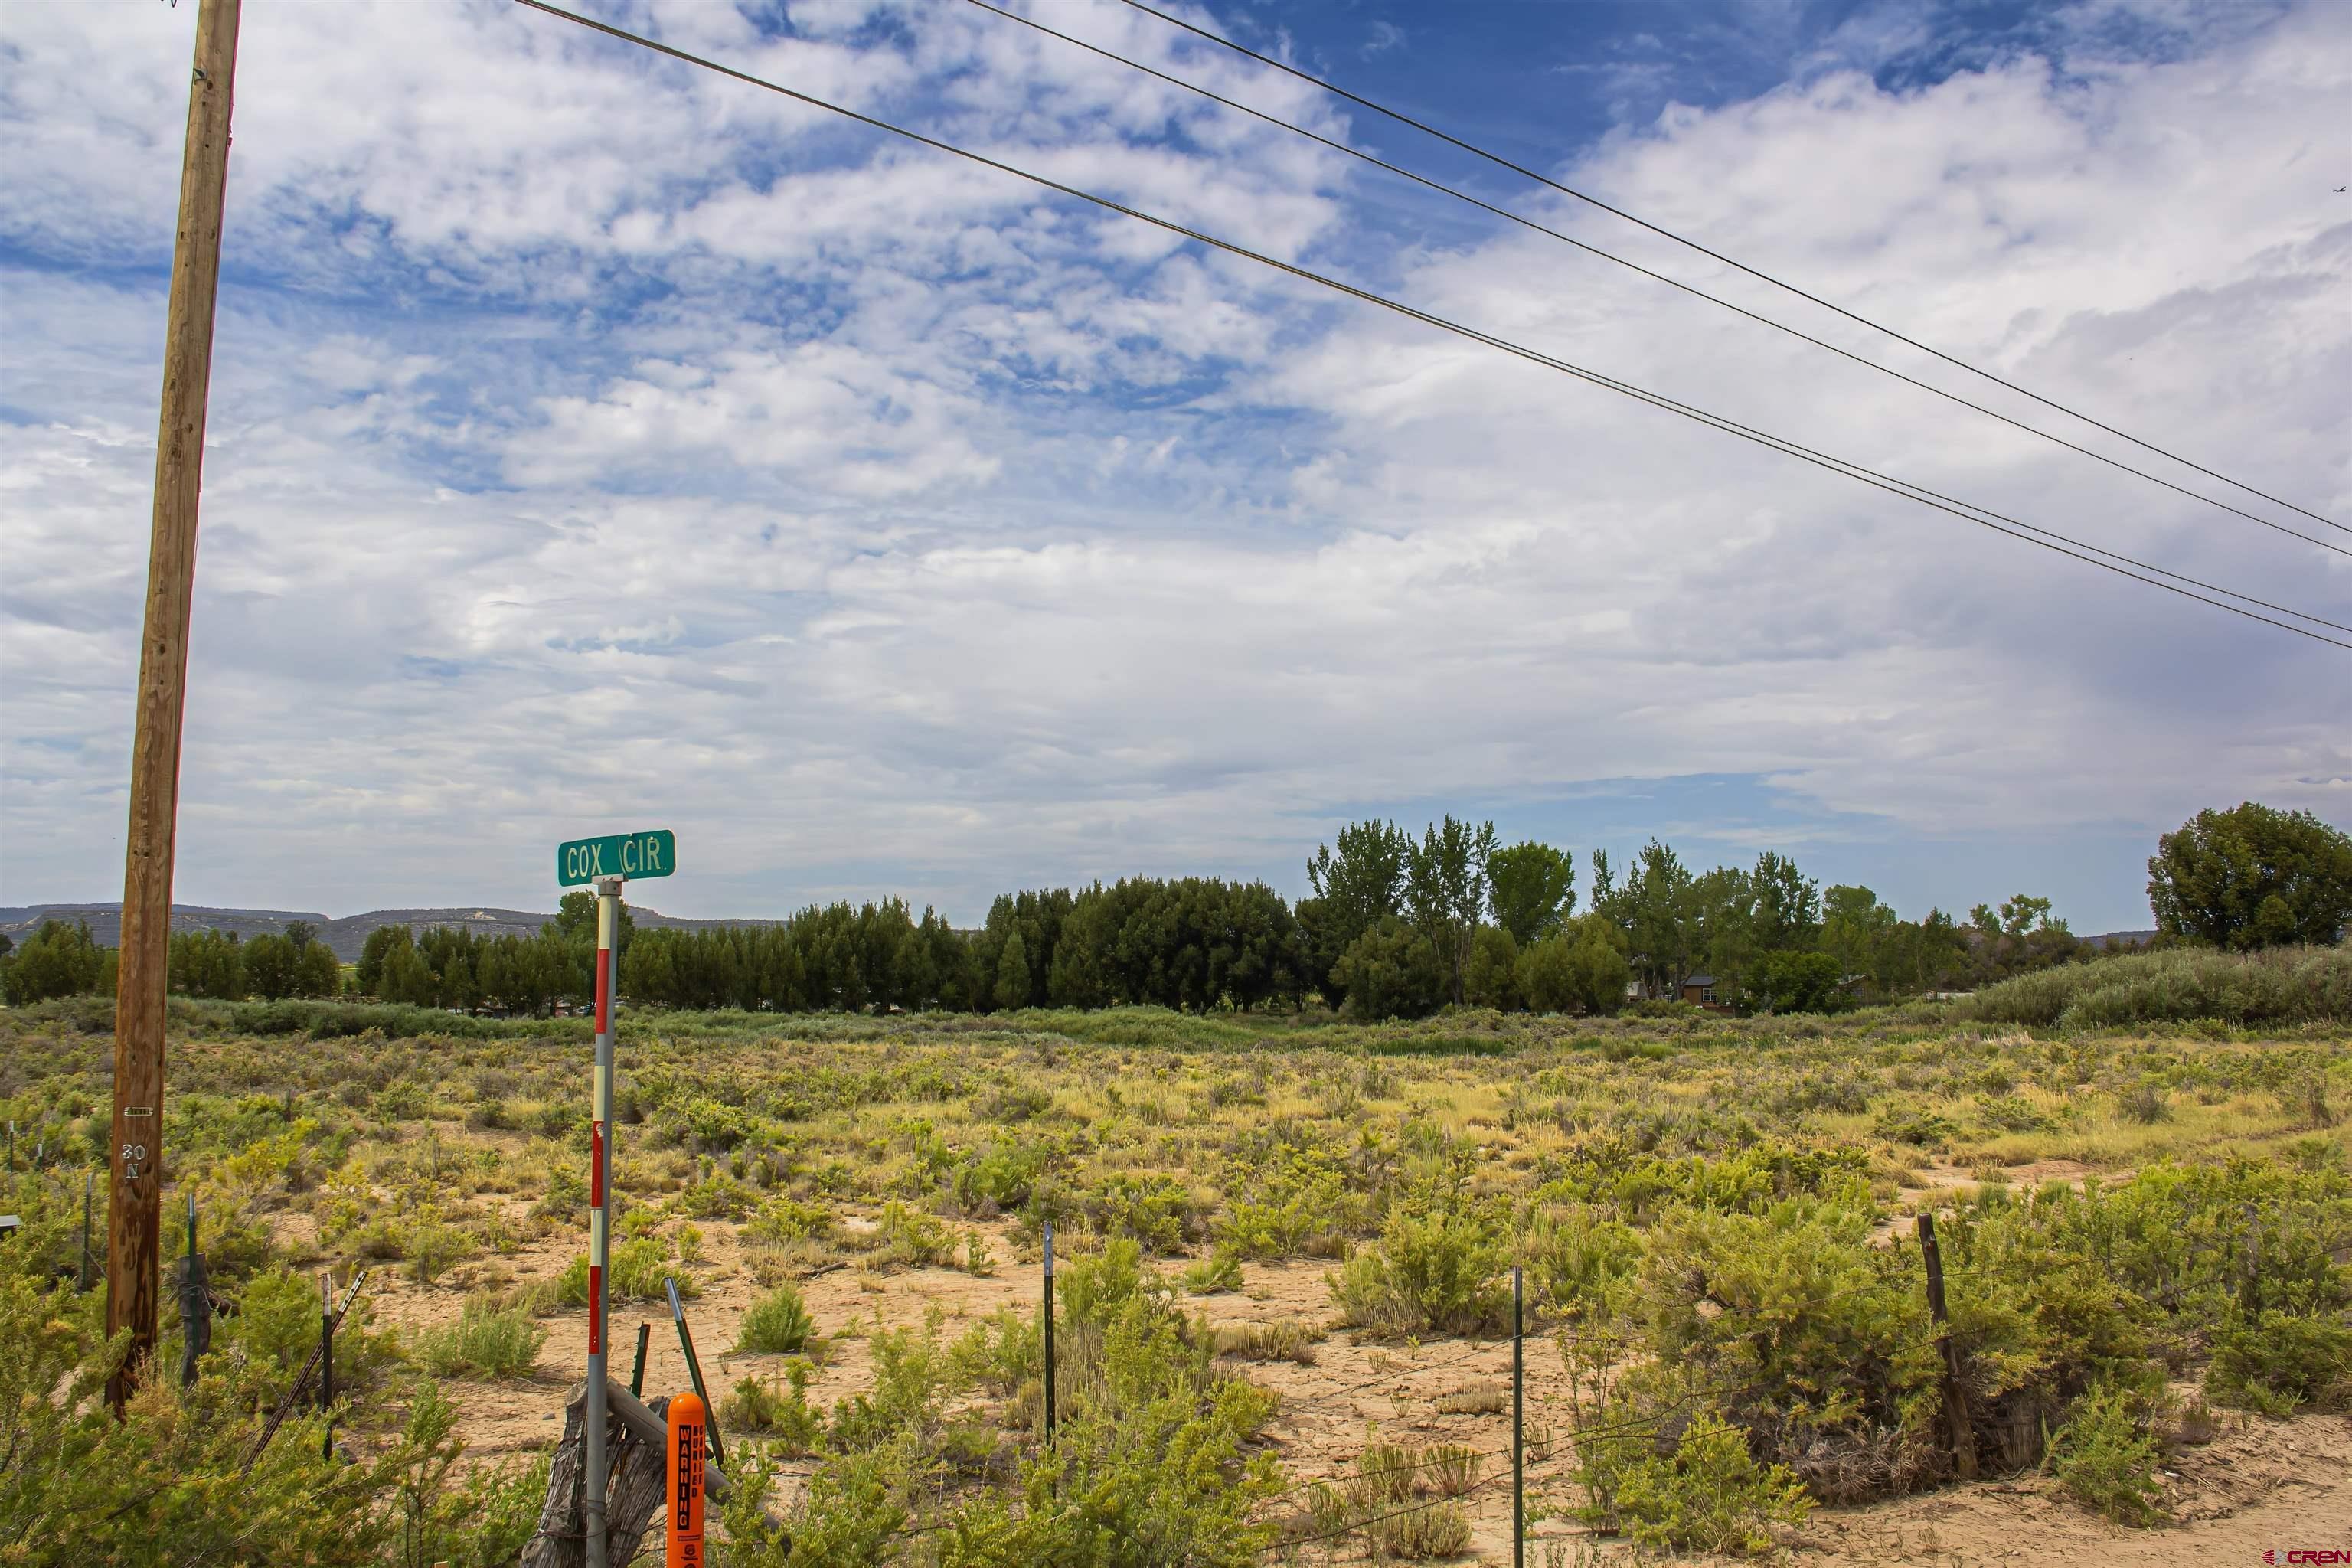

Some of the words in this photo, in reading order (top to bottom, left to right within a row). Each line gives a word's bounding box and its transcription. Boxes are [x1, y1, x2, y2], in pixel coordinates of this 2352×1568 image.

[567, 844, 603, 878] COX
[623, 838, 661, 873] CIR
[122, 1144, 146, 1160] 30
[126, 1164, 139, 1178] N
[679, 1428, 689, 1527] WARNING
